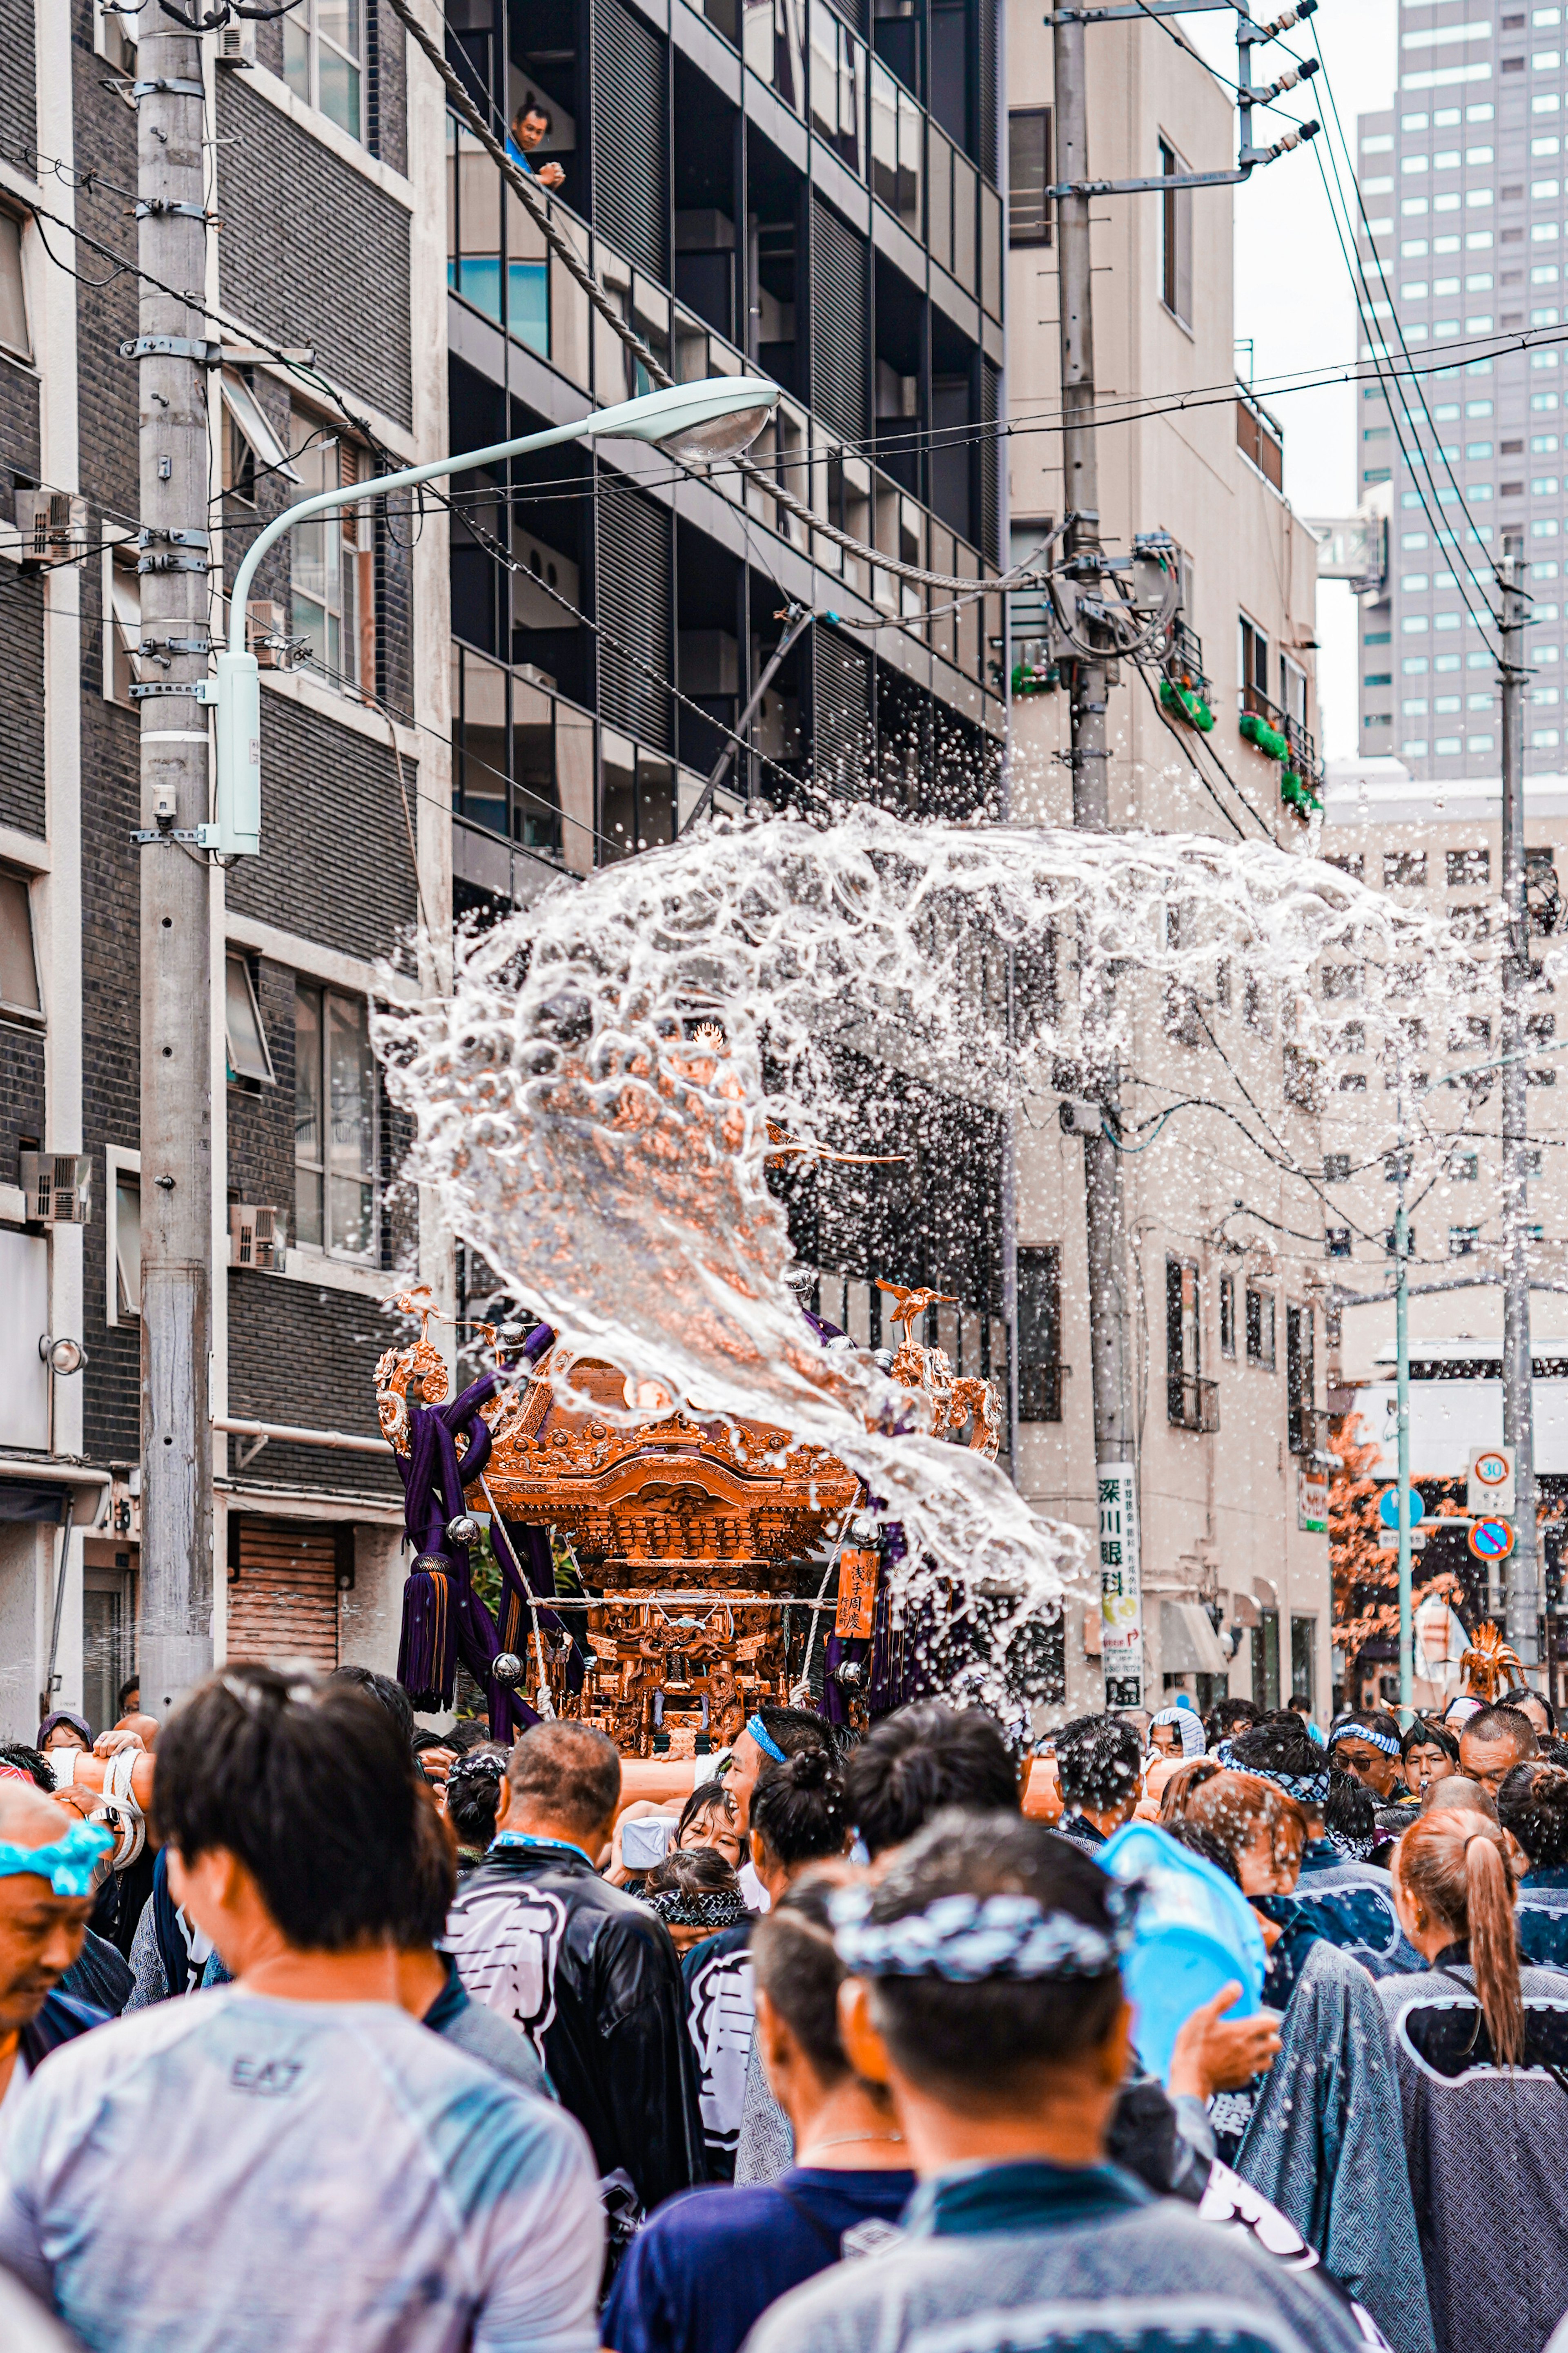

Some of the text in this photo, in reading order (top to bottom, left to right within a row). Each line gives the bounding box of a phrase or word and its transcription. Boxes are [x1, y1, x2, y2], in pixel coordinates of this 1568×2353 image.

[1483, 1461, 1502, 1477] 30
[1099, 1479, 1123, 1597] 深川眼科
[844, 1563, 865, 1630] 浅子周慶
[230, 2054, 305, 2092] EA7
